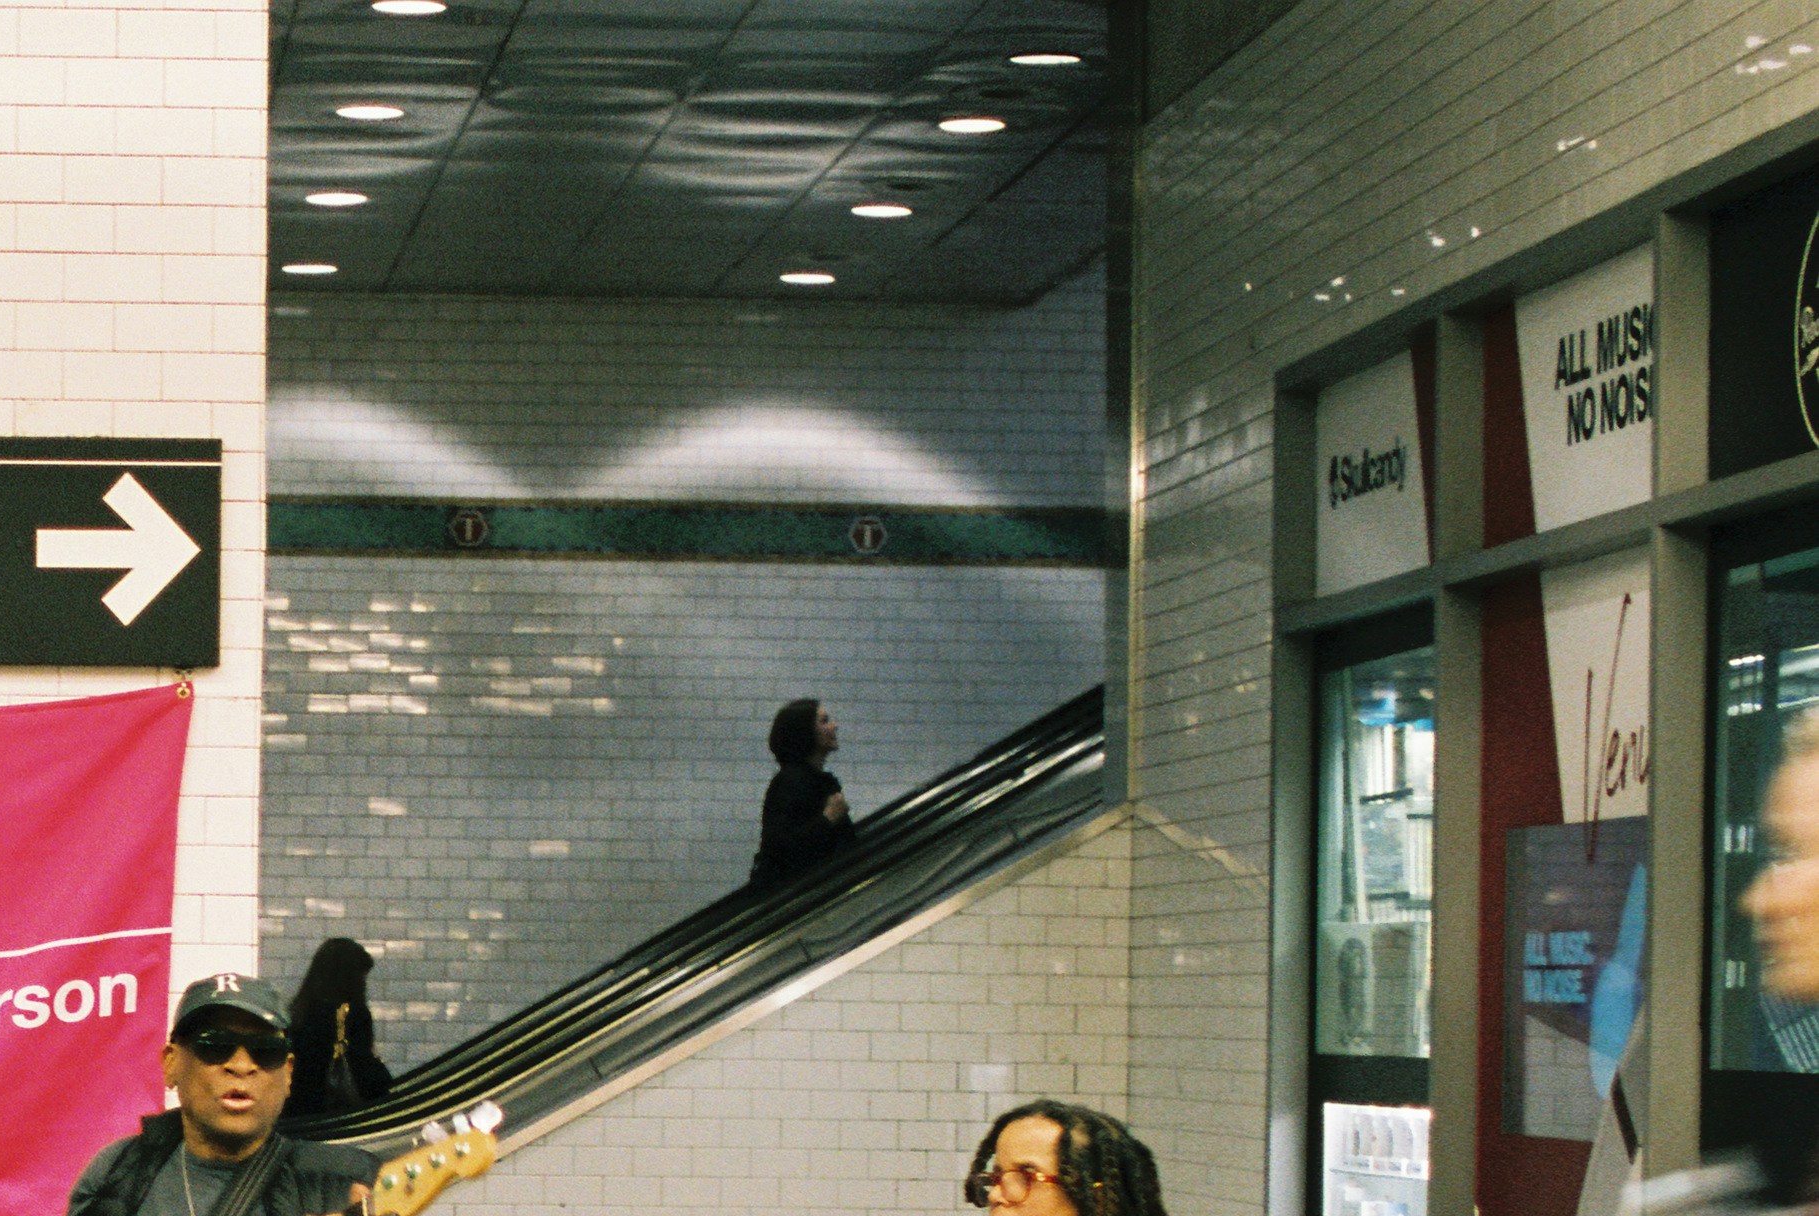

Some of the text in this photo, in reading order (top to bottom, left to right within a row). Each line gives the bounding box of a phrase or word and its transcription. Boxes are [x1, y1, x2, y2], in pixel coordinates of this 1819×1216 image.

[1555, 330, 1591, 390] ALL
[1568, 365, 1654, 446] NO NOIS
